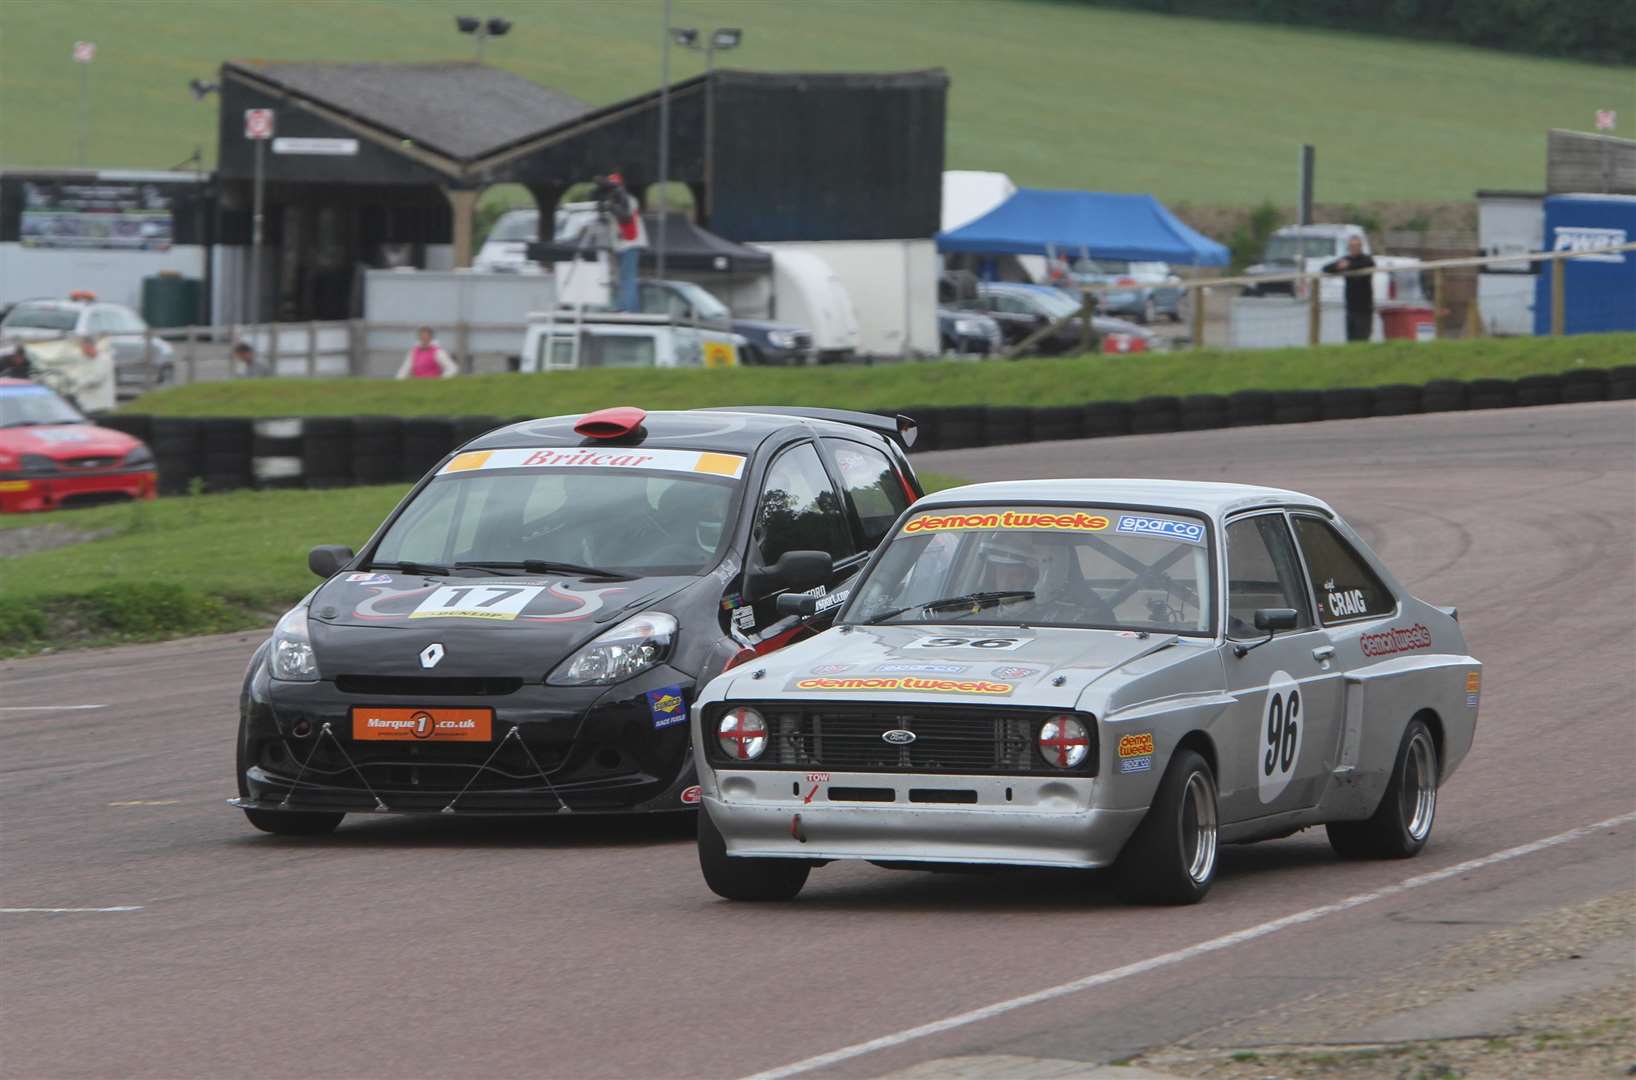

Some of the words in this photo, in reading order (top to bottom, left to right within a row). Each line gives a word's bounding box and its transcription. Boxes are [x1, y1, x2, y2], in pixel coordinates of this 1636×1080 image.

[522, 449, 655, 466] Britcar
[902, 513, 999, 533] demon
[1002, 510, 1110, 531] tweeks
[1120, 516, 1200, 538] sparco
[444, 587, 525, 608] 17
[1328, 589, 1367, 617] CRAIG
[922, 638, 1019, 649] 96
[1360, 633, 1394, 657] demon
[1391, 623, 1431, 652] tweeks
[797, 676, 899, 691] demon
[901, 676, 1012, 693] tweeks
[1119, 733, 1152, 747] demon
[1264, 689, 1300, 777] 96
[1119, 744, 1153, 757] tweeks
[806, 773, 830, 782] TOW
